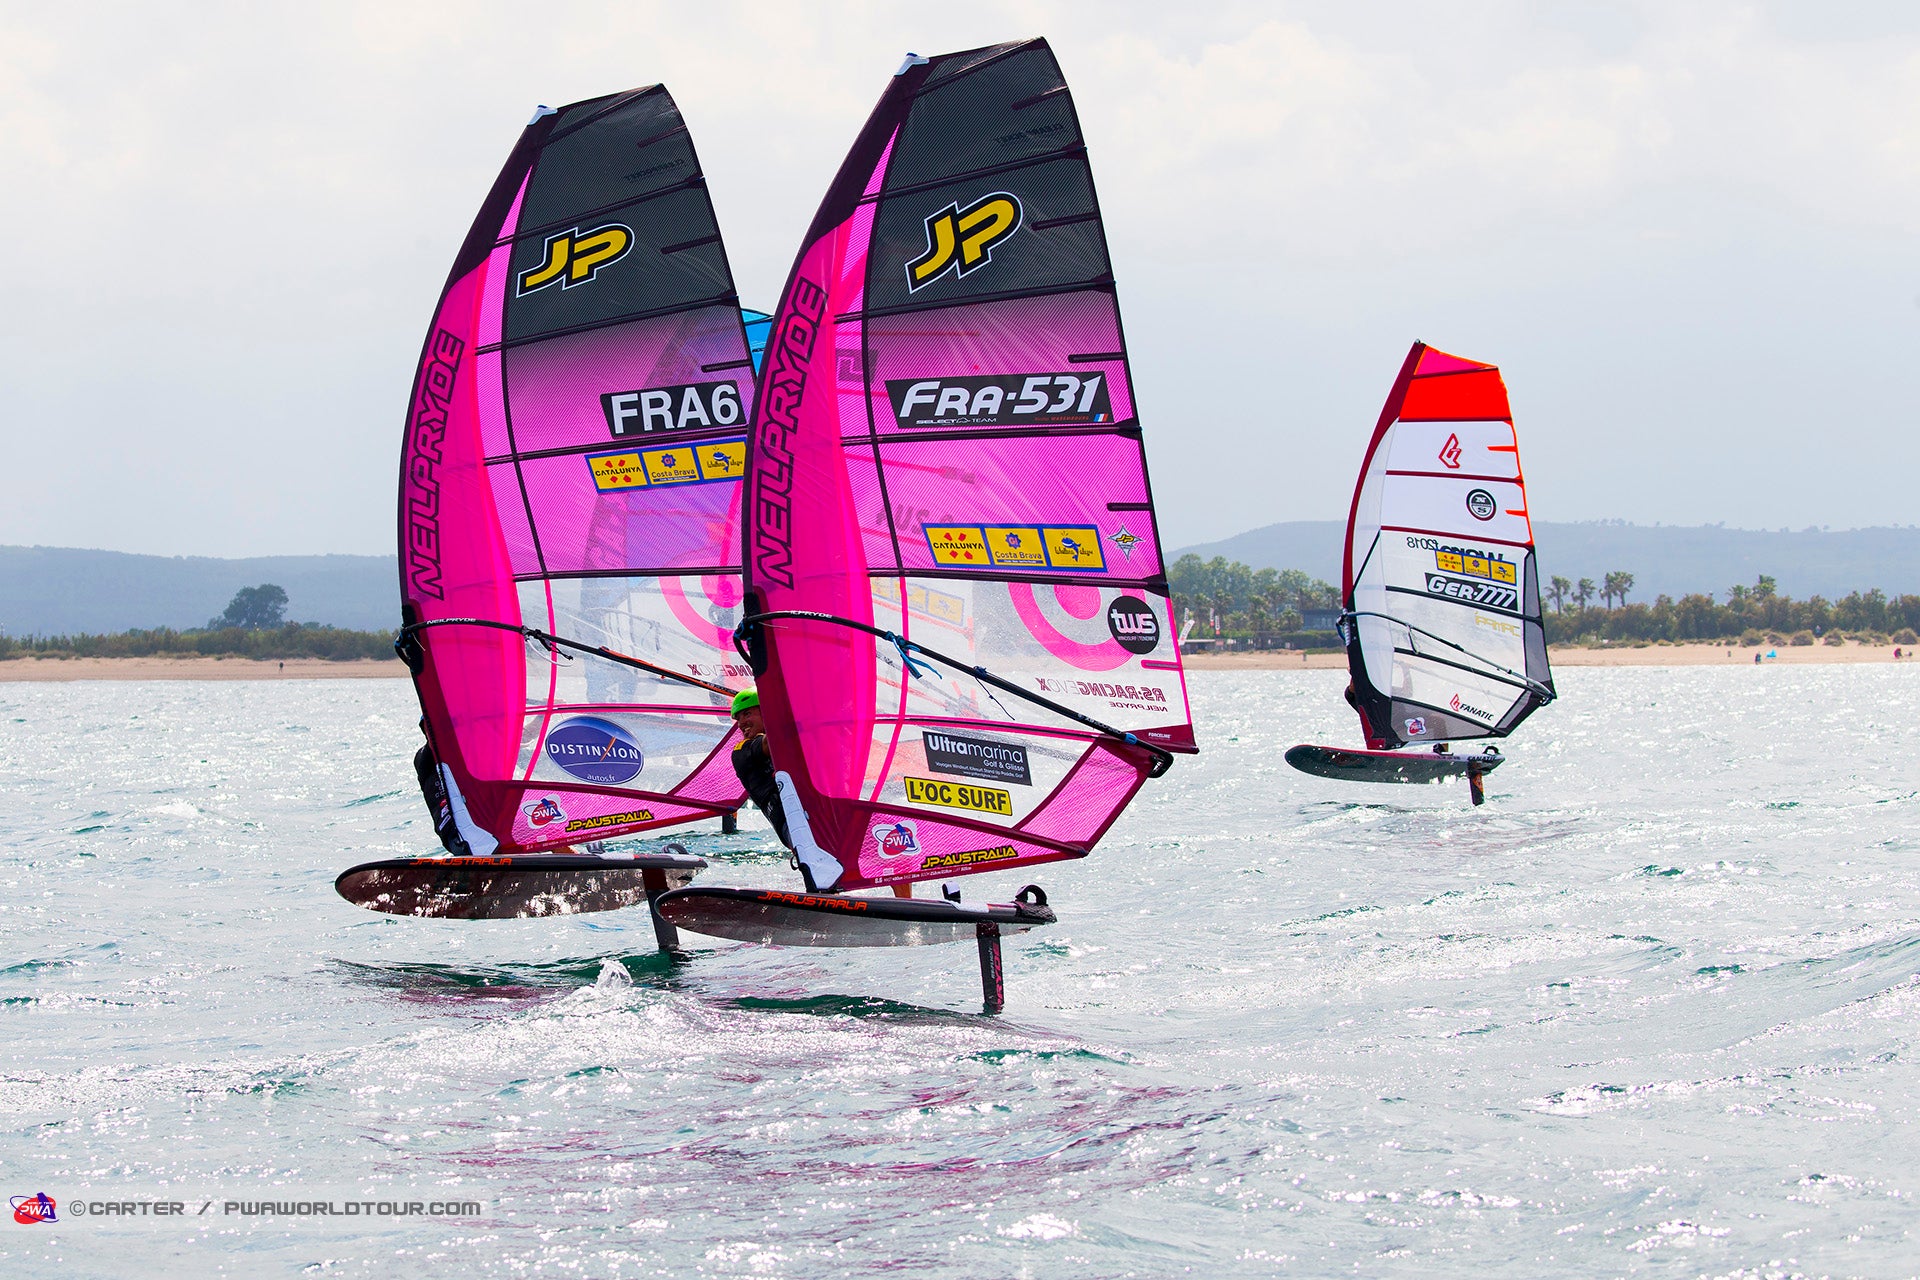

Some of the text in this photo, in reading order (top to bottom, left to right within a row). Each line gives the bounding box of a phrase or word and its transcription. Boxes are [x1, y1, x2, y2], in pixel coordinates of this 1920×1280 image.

[908, 194, 1020, 289] JP
[520, 225, 632, 294] JP
[610, 384, 739, 435] FRA6
[755, 276, 829, 590] NEILPRYDE
[409, 328, 465, 600] NEILPRYDE
[594, 466, 642, 477] CATALUNYA
[651, 469, 696, 478] Costa Brava
[933, 541, 984, 550] CATALUNYA
[1116, 534, 1134, 543] JP
[995, 551, 1042, 560] Costa Brava
[426, 617, 477, 625] NEILPRYDE
[1110, 608, 1157, 634] tws
[1460, 703, 1494, 721] FANATIC
[549, 740, 639, 761] DISTINXION
[927, 734, 1024, 763] Ultramarina
[909, 781, 1007, 811] L'OC SURF
[533, 805, 558, 820] PWA
[566, 810, 654, 832] JP-AUSTRALIA
[886, 834, 911, 848] PWA
[922, 846, 1017, 869] JP-AUSTRALIA
